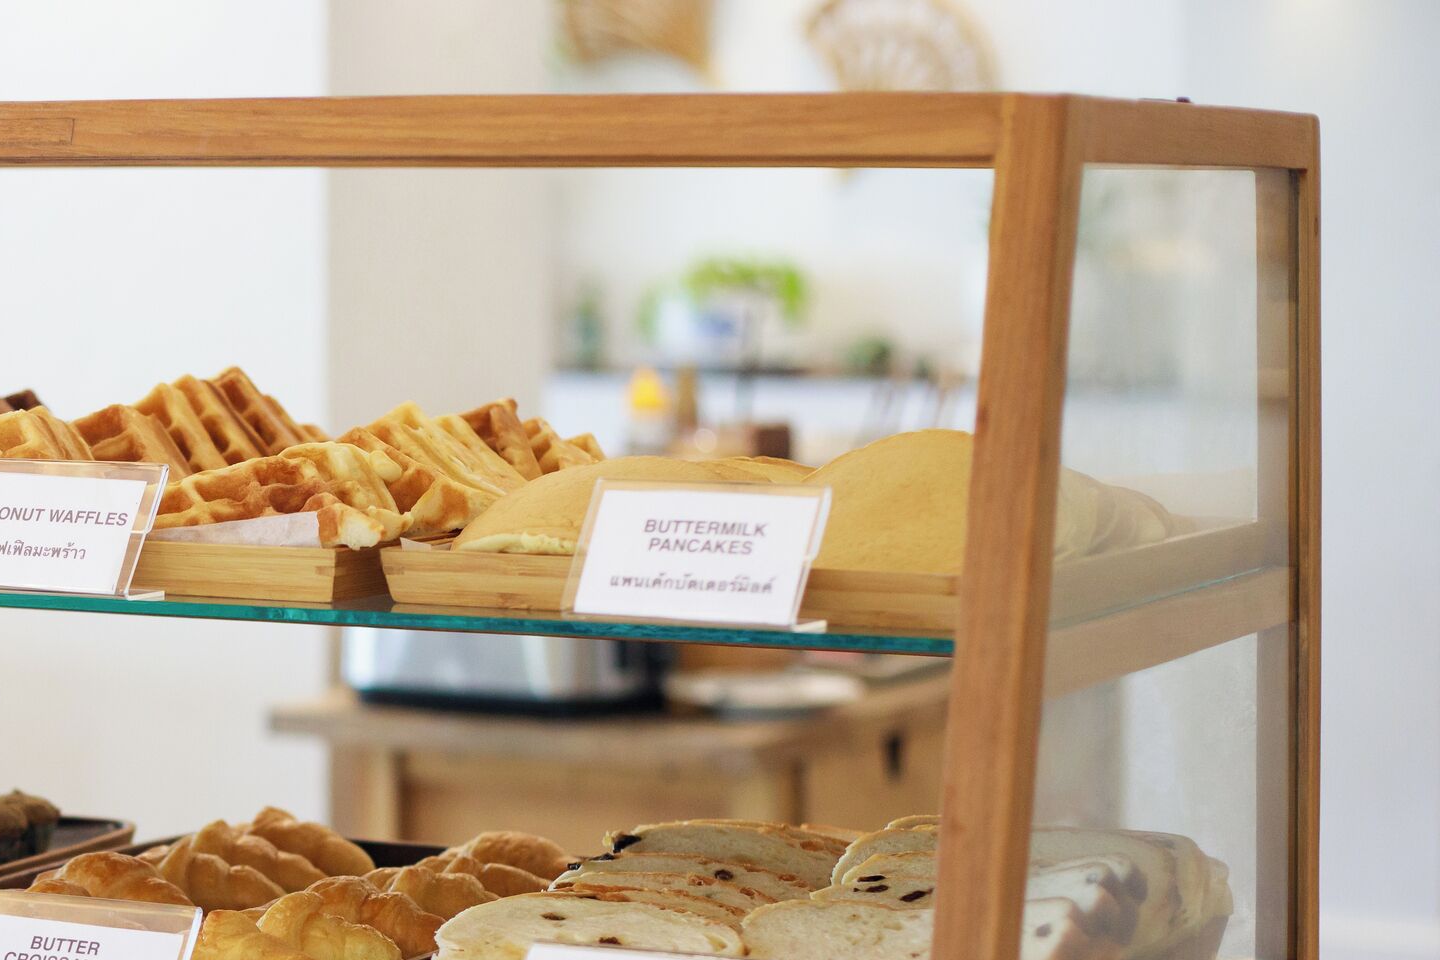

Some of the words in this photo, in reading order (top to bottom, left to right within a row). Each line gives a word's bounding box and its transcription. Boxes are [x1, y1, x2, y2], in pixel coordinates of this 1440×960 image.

[49, 509, 129, 527] WAFFLES
[643, 518, 768, 537] BUTTERMILK
[647, 537, 754, 556] PANCAKES
[30, 935, 101, 956] BUTTER
